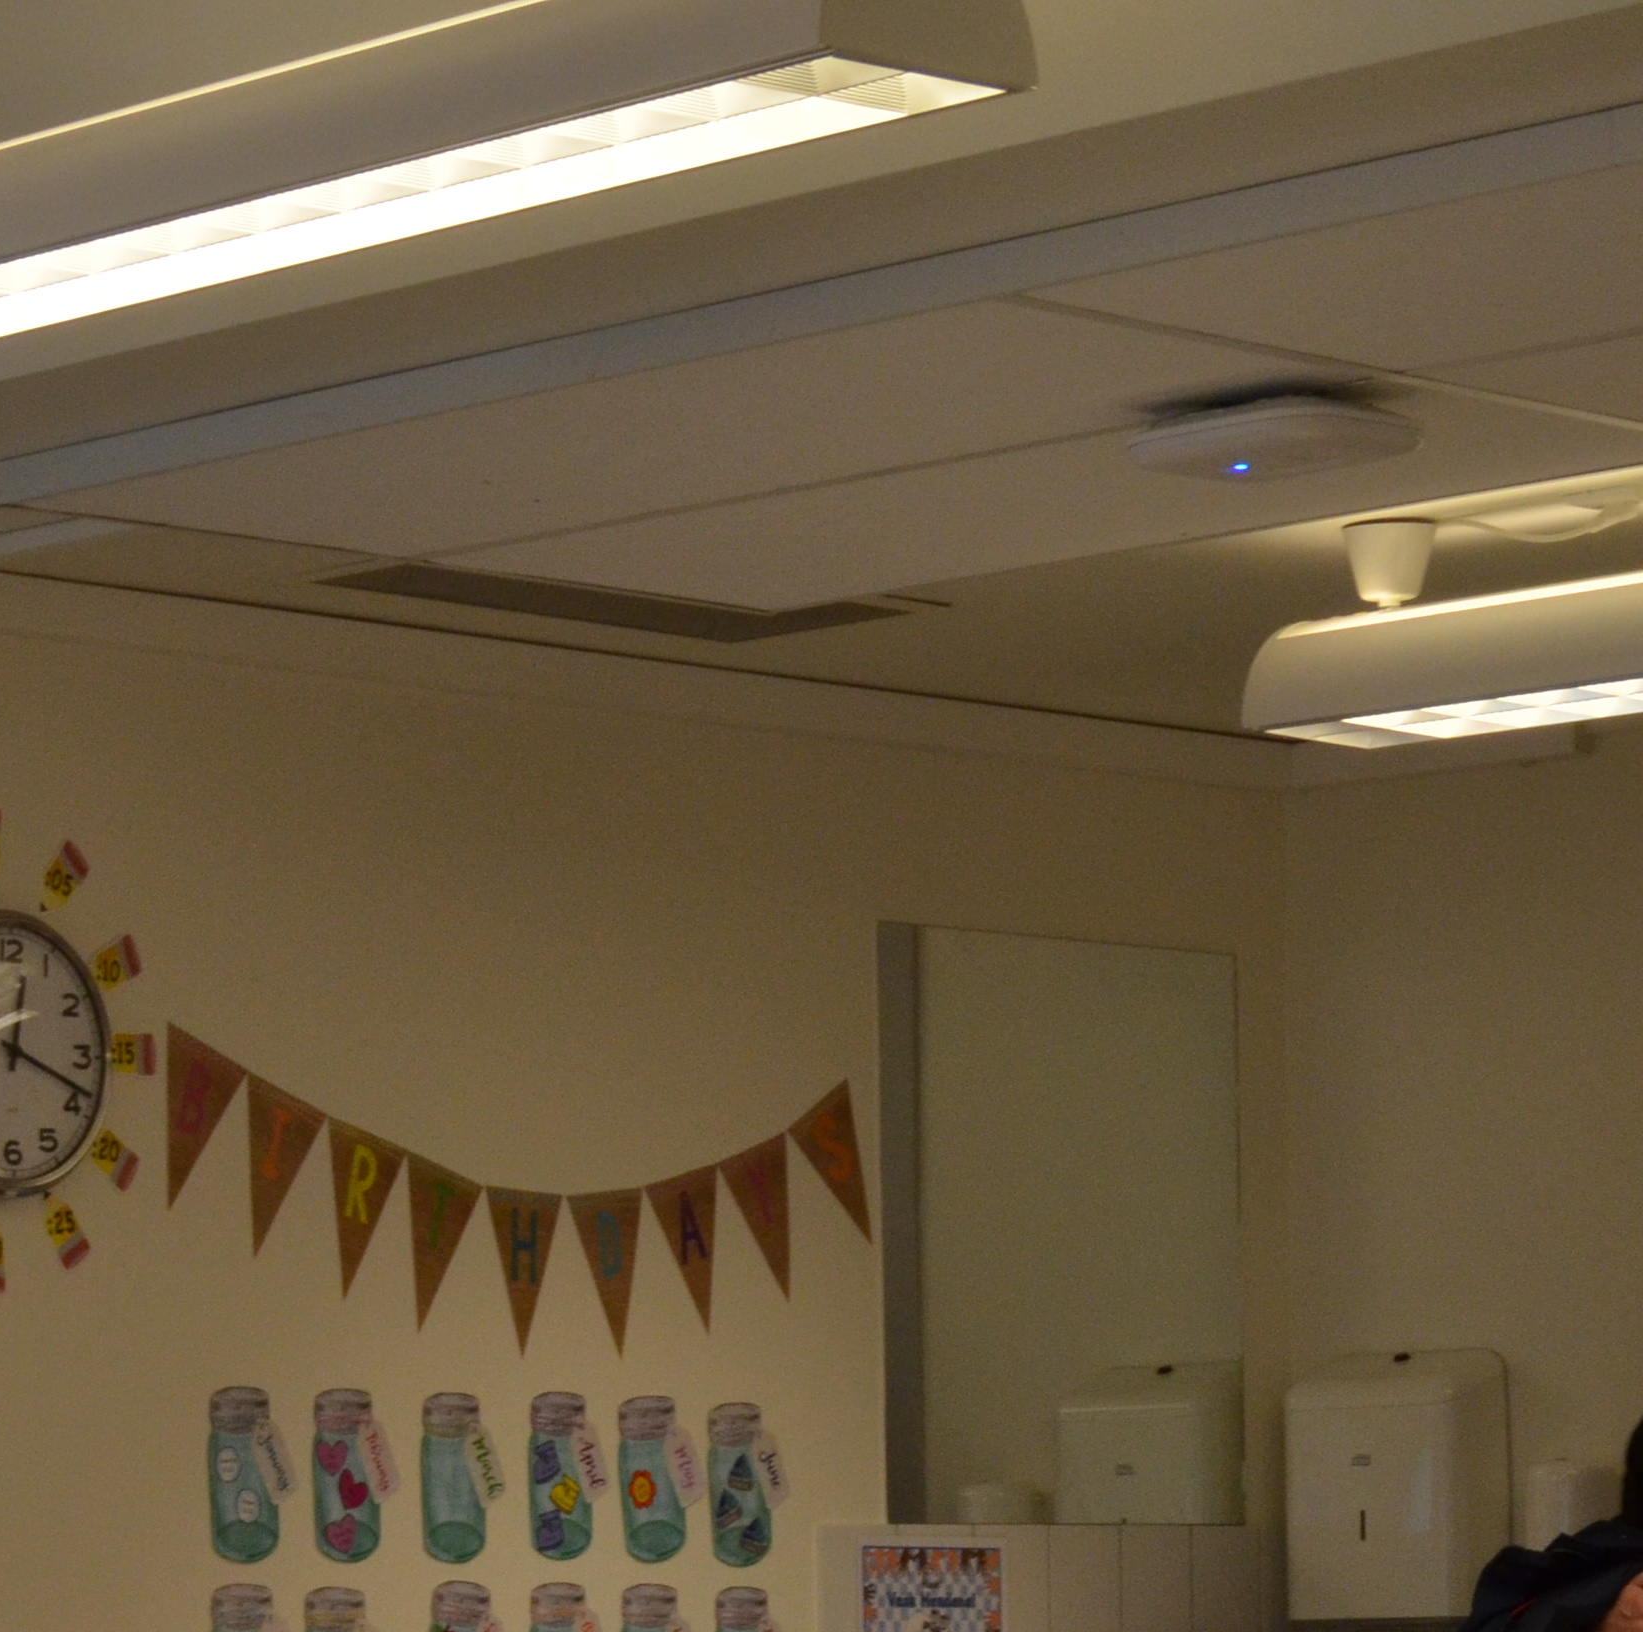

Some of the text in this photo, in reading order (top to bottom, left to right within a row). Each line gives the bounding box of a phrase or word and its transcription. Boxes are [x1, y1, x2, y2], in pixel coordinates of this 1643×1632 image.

[0, 939, 23, 964] 12
[42, 953, 51, 978] 1
[61, 993, 80, 1018] 2
[73, 1044, 93, 1070] 3
[64, 1090, 82, 1115] 4
[4, 1140, 23, 1166] 6
[39, 1128, 59, 1153] 5
[176, 1060, 856, 1284] BIRTHDAYS
[578, 1436, 606, 1490] April
